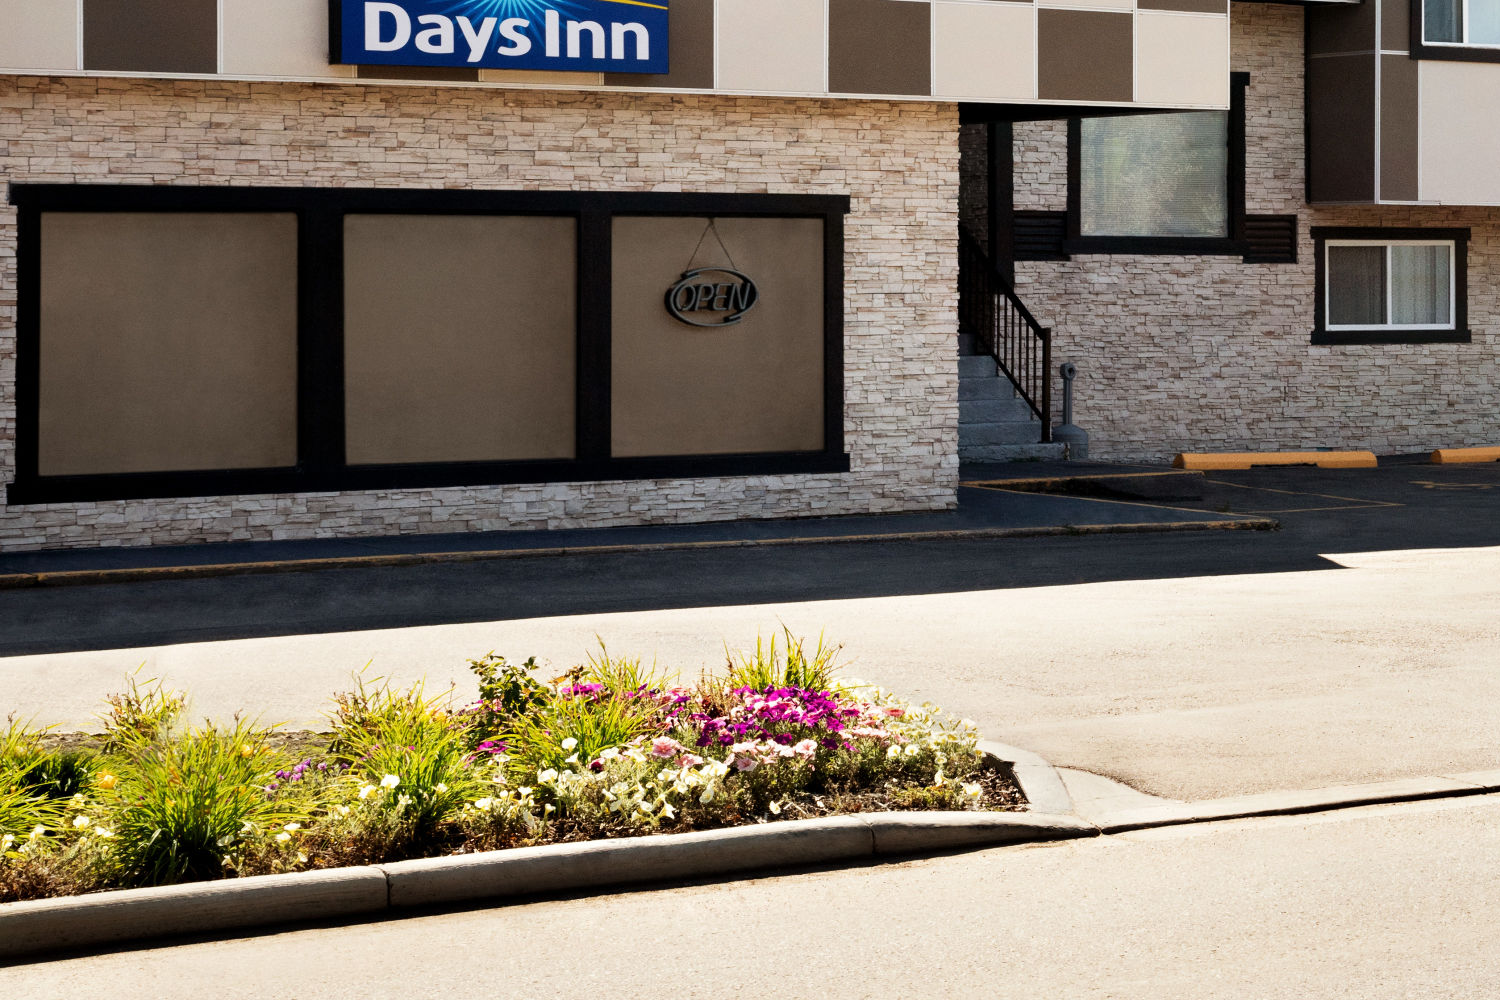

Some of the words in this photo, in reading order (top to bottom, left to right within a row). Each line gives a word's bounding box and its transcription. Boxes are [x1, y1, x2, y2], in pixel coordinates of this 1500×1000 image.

[364, 1, 532, 63] Days
[545, 9, 650, 61] Inn
[675, 282, 751, 311] OPEN
